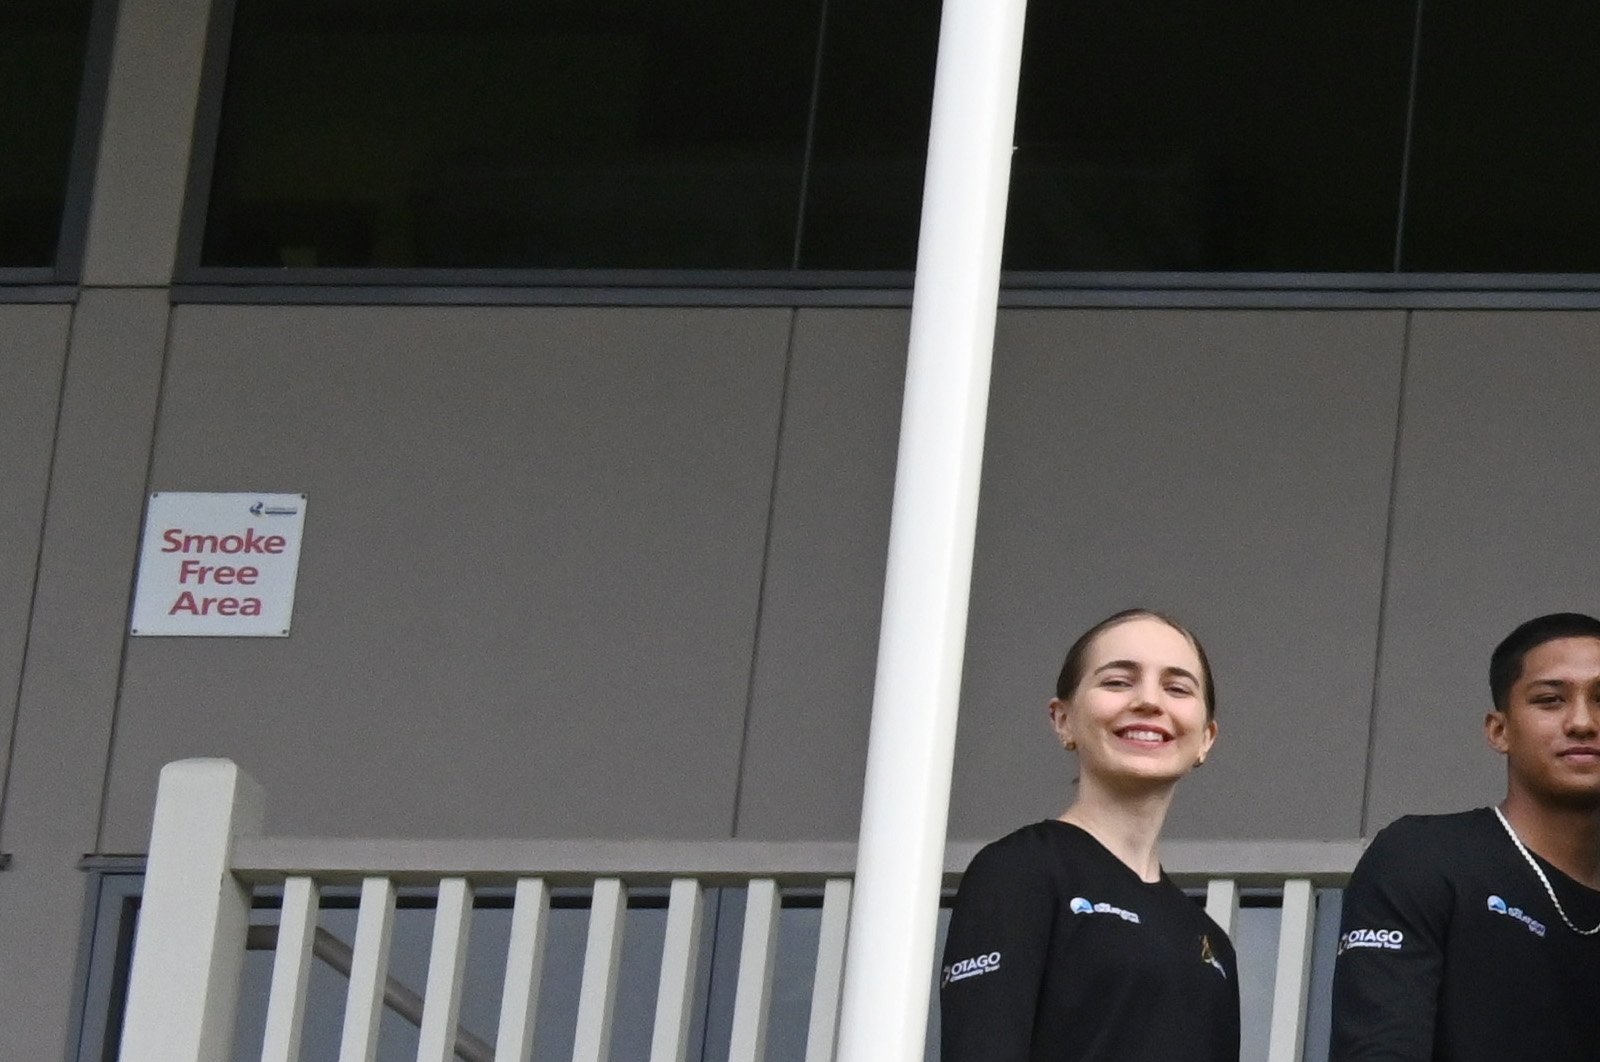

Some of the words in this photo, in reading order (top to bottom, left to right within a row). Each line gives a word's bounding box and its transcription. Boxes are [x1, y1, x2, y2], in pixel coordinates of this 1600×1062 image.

[161, 528, 287, 554] Smoke
[178, 560, 260, 585] Free
[168, 590, 263, 616] Area
[1348, 929, 1404, 944] OTAGO
[951, 952, 1001, 976] OTAGO
